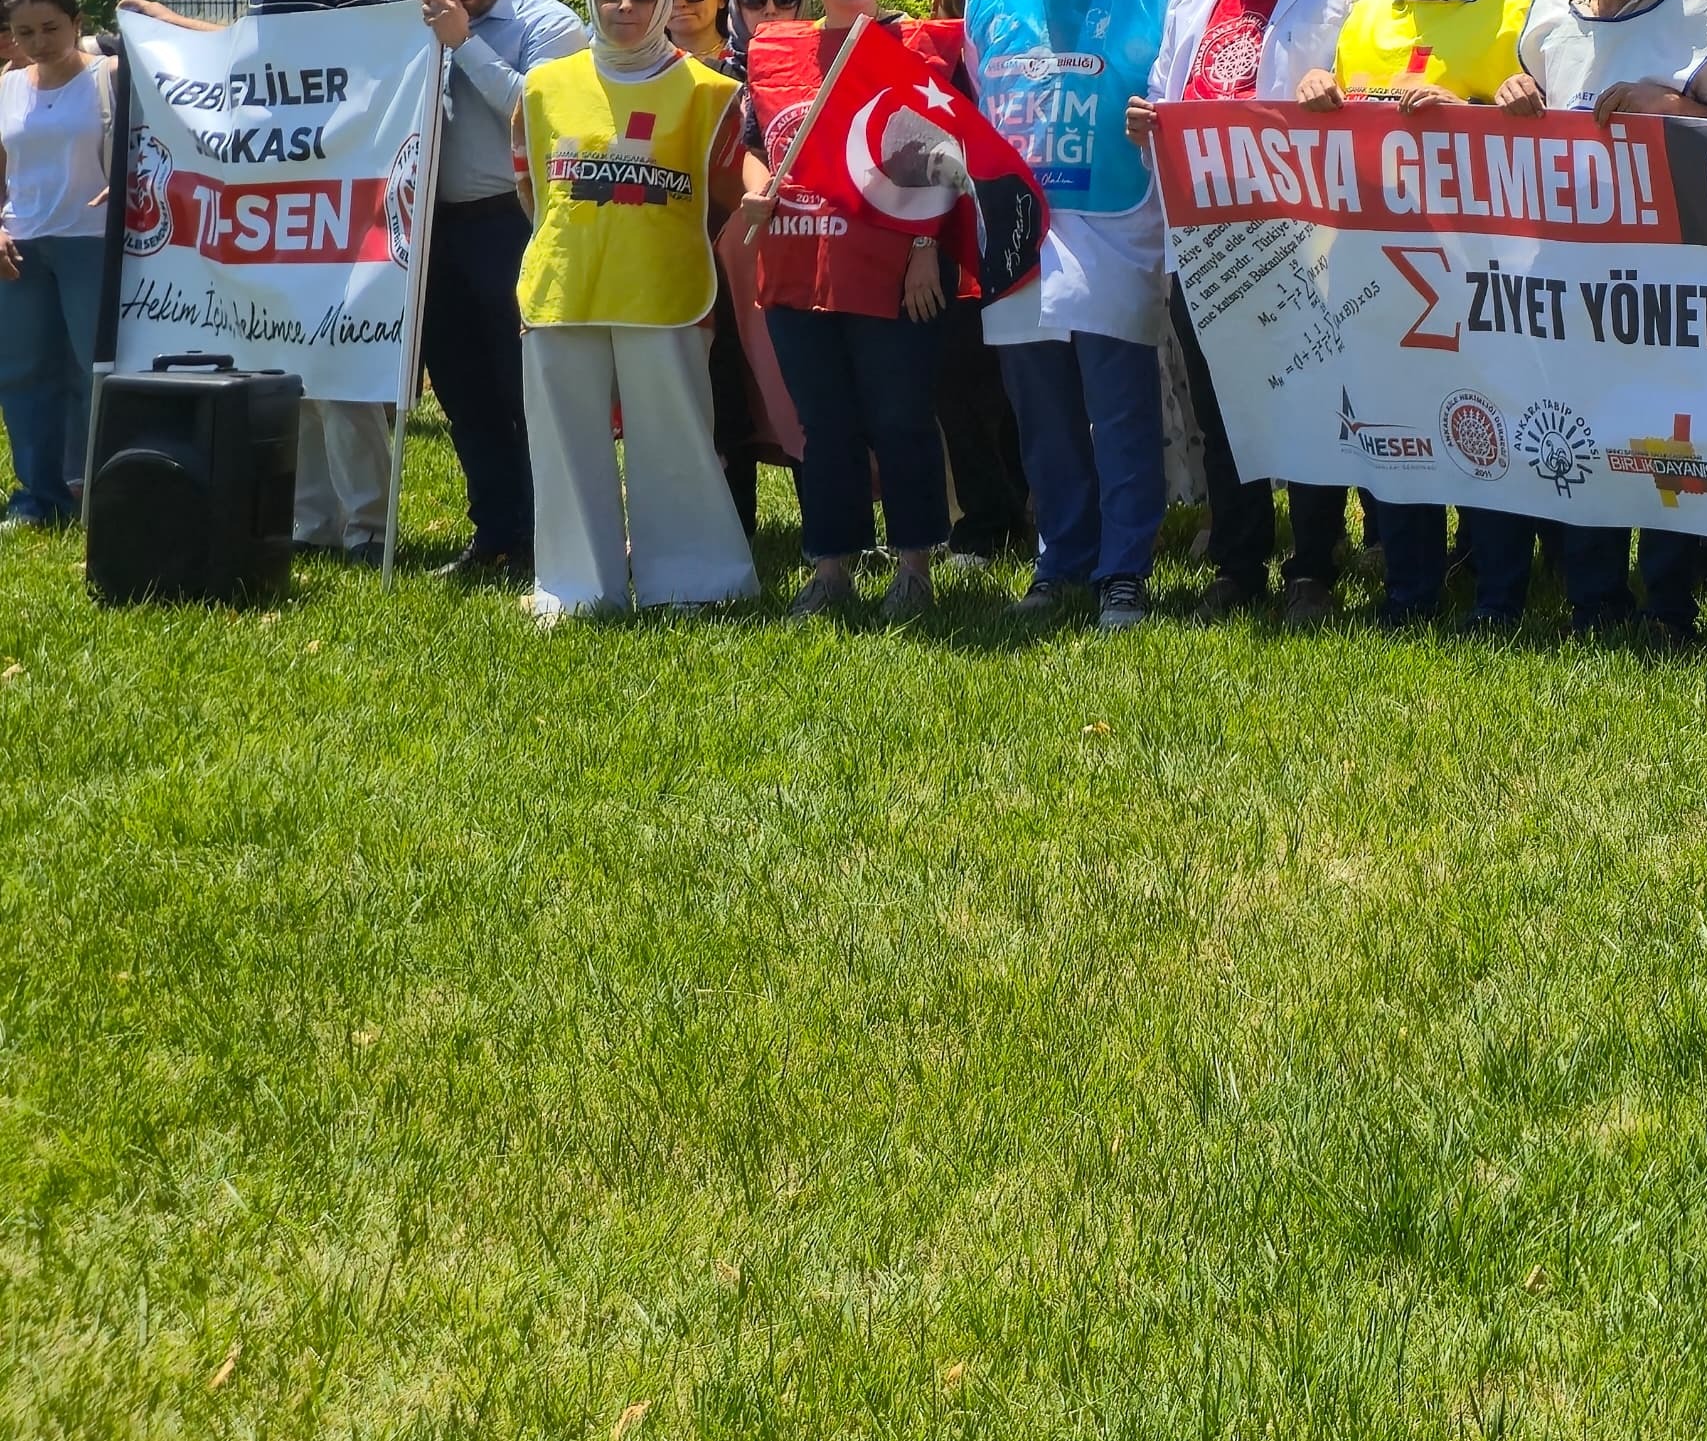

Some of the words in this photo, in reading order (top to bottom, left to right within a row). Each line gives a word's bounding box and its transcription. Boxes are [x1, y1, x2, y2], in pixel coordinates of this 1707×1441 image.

[1056, 56, 1094, 70] BİRLİĞİ
[986, 81, 1098, 126] HEKİM
[1003, 127, 1095, 164] RLİĞİ
[1183, 126, 1362, 213] HASTA
[1381, 124, 1659, 225] GELMEDİ!
[121, 277, 200, 328] Hekim
[1513, 401, 1541, 452] ANKARA
[1541, 398, 1573, 417] TABİP
[1575, 416, 1602, 461] ODASI
